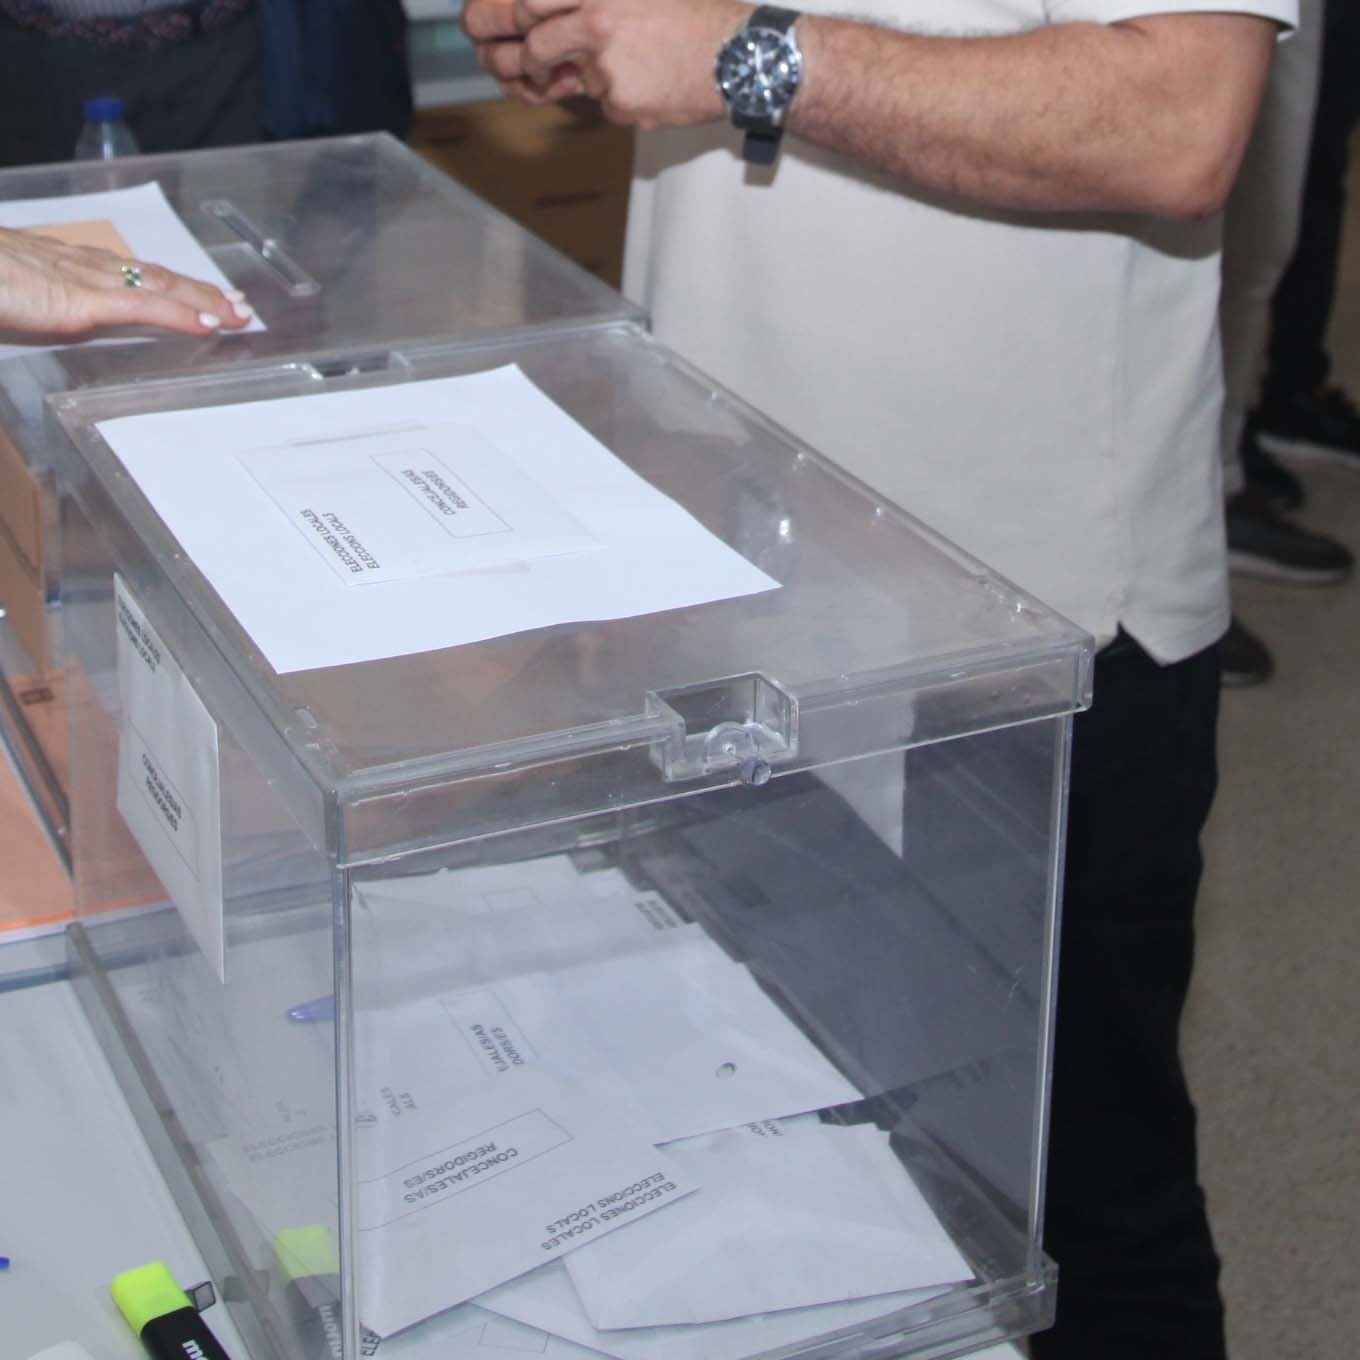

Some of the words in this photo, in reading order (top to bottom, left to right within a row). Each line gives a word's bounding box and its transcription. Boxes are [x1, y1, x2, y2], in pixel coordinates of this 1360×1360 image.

[323, 535, 364, 573] ELECCIONES
[342, 534, 381, 569] ELECCIONS
[403, 1141, 497, 1189] REGIDORS/ES
[404, 1147, 518, 1204] CONCEJALES/AS
[597, 1170, 666, 1210] ELECCIONS
[600, 1180, 678, 1223] ELECCIONES
[541, 1217, 603, 1251] LOCALES
[545, 1203, 596, 1235] LOCALS
